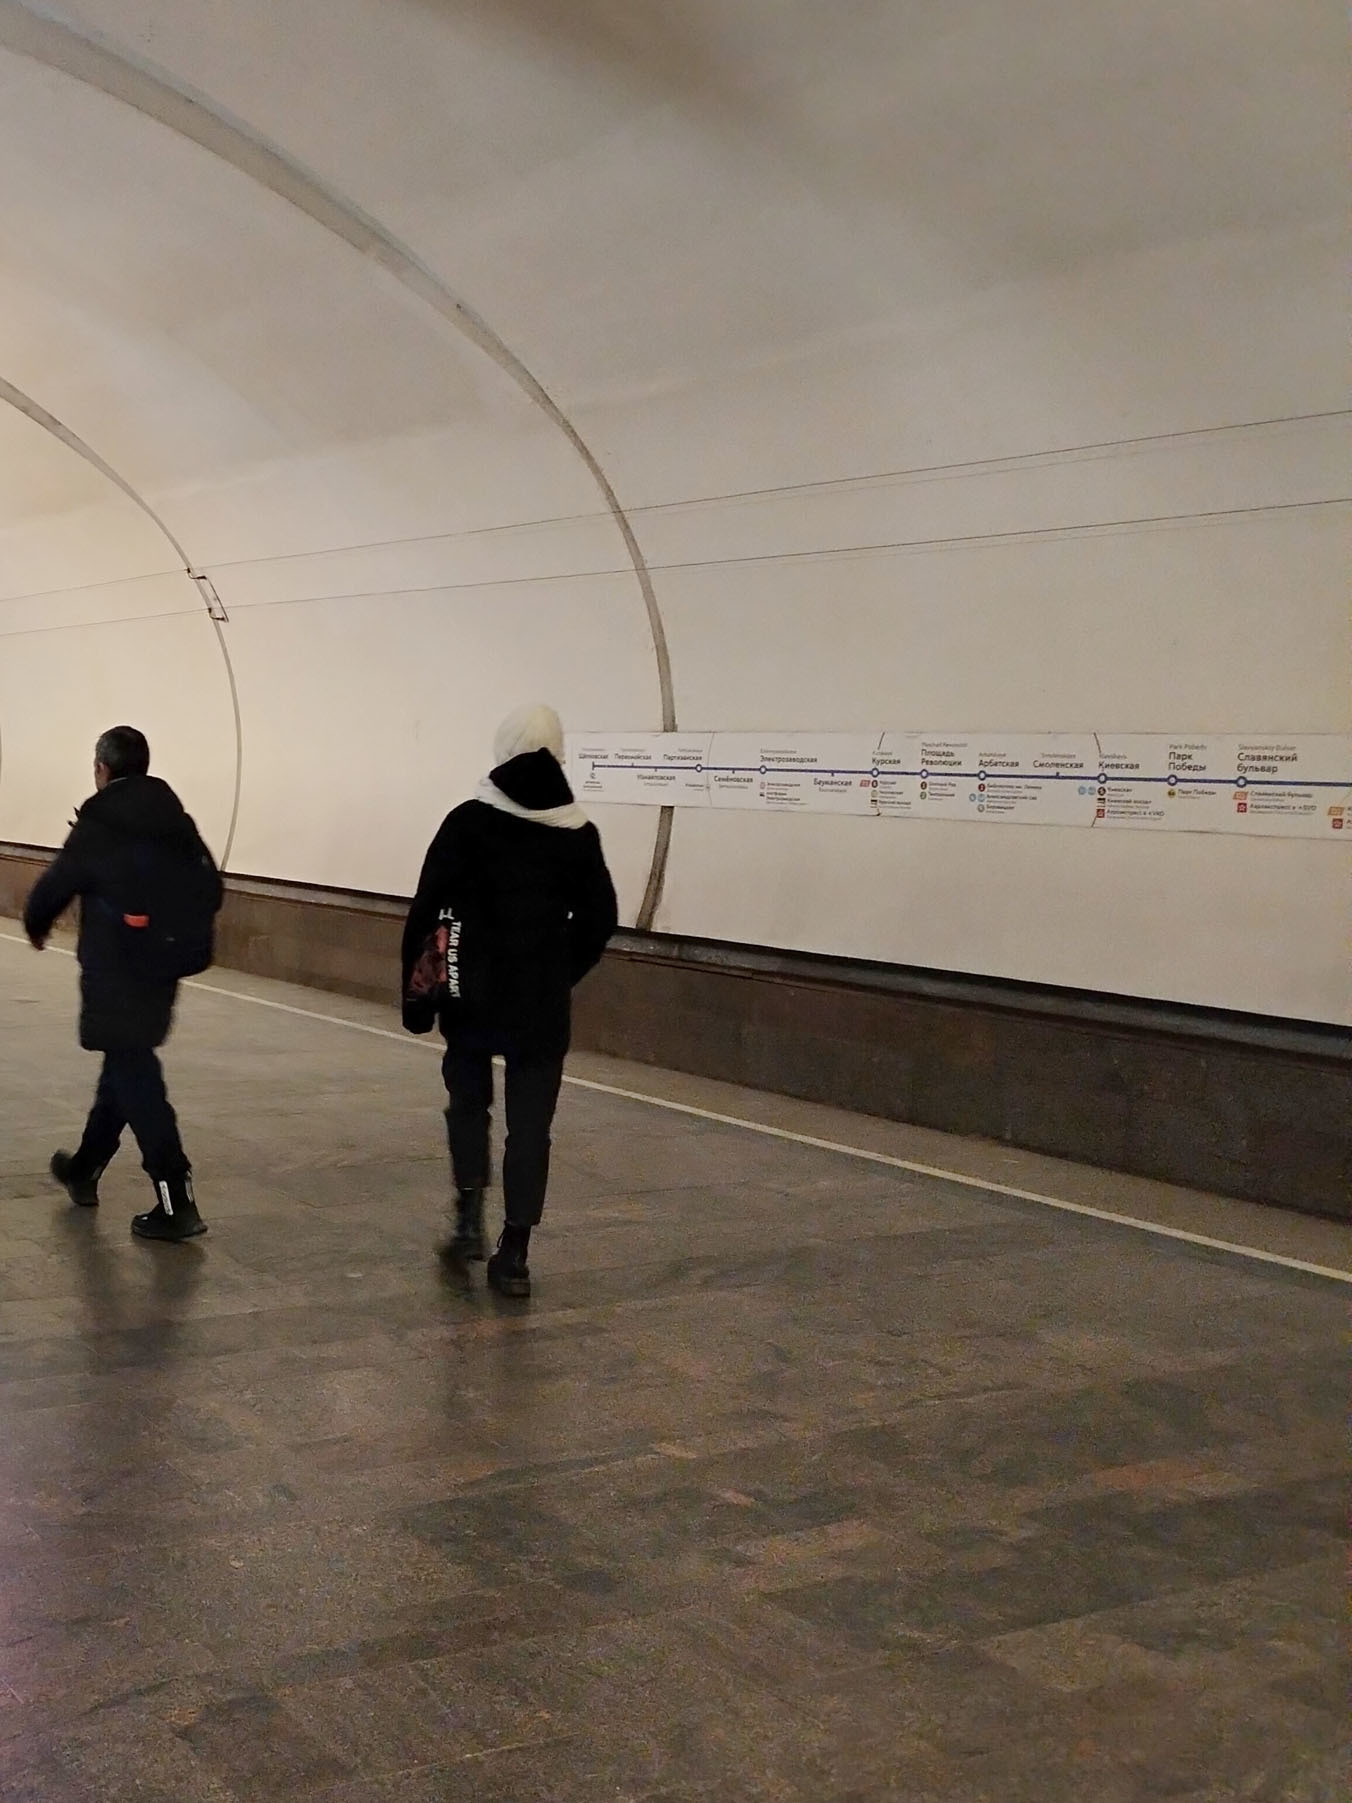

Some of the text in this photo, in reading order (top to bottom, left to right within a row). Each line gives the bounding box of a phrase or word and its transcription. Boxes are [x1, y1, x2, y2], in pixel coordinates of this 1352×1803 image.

[921, 749, 955, 758] Площадь
[1169, 752, 1193, 761] Парк
[1237, 752, 1298, 762] Славянский
[760, 755, 818, 763] Электрозаводская
[871, 758, 901, 767] Курская
[921, 758, 962, 767] Революции
[978, 759, 1019, 768] Арбатская
[1033, 760, 1084, 769] Смоленская
[1098, 761, 1140, 770] Киевская
[1169, 762, 1207, 771] Победы
[1236, 763, 1278, 774] бульвар
[813, 778, 852, 787] Бауманская
[447, 920, 462, 997] TEAR US APART
